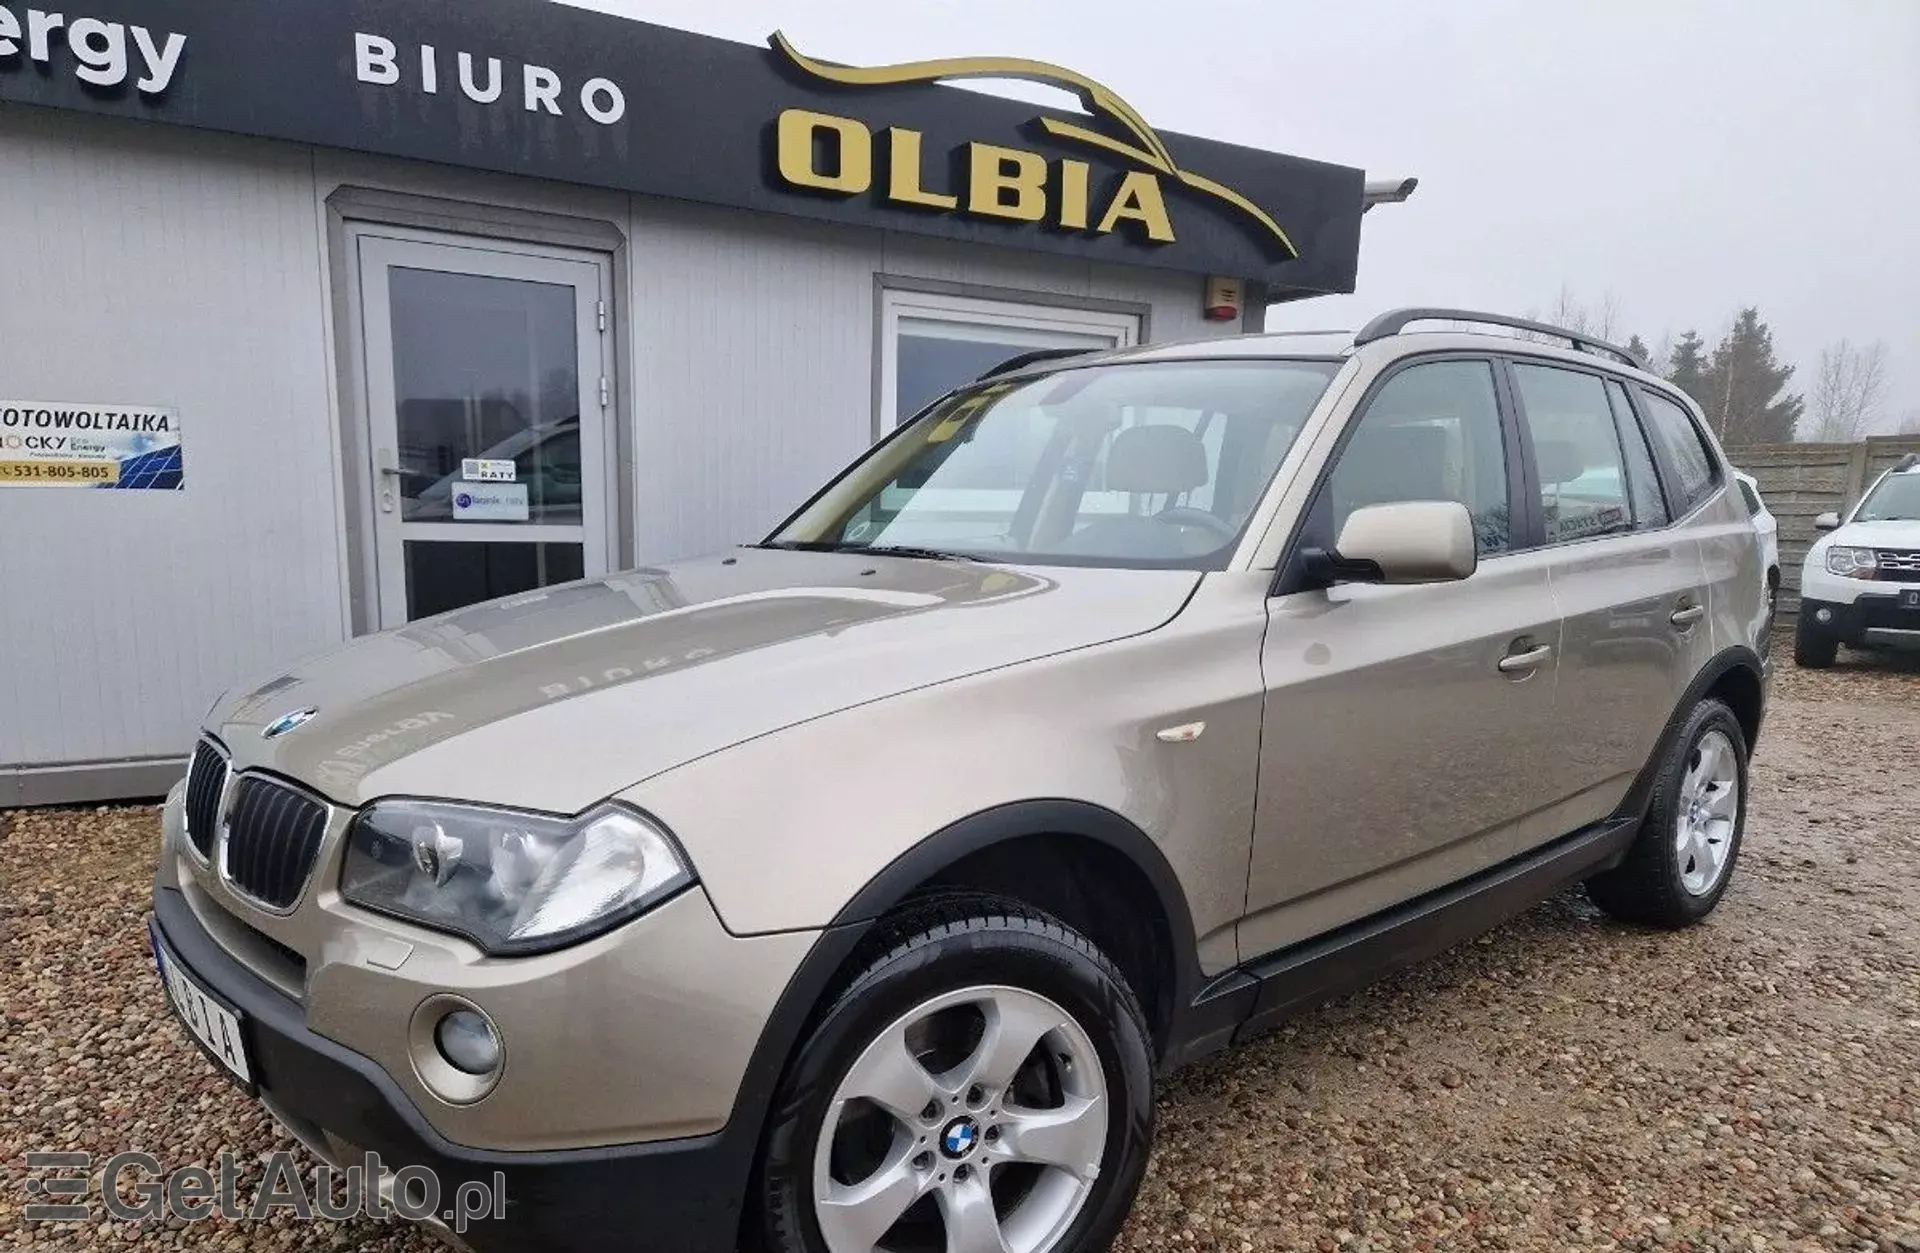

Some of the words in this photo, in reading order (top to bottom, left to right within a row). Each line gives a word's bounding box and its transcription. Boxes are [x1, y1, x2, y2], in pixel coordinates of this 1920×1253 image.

[355, 32, 626, 125] BIURO
[778, 108, 1176, 243] OLBIA
[0, 408, 169, 432] OTOWOLTAIKA
[0, 435, 66, 449] OCKY
[71, 443, 105, 452] Energy
[14, 465, 109, 477] 531-805-805
[481, 471, 514, 479] RATY
